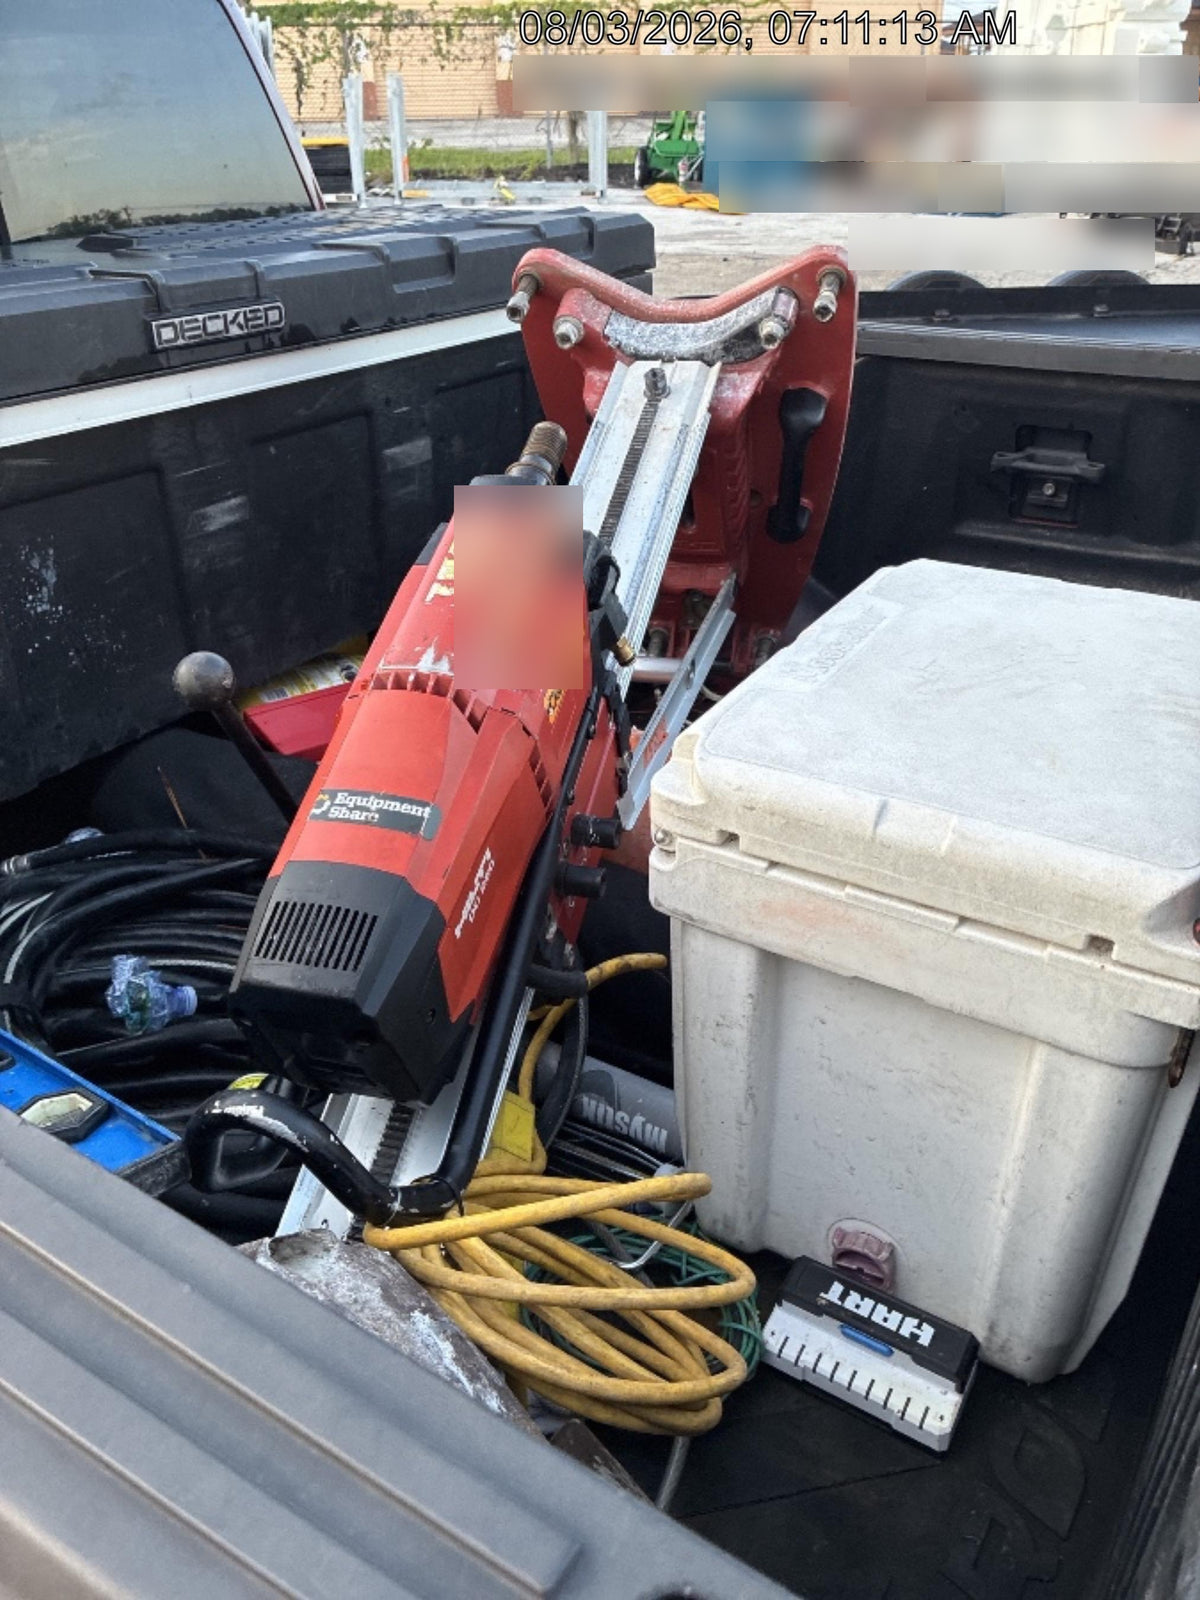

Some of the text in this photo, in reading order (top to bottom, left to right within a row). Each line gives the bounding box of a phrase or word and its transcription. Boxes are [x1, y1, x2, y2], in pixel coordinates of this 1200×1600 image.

[153, 304, 284, 346] DECKED
[333, 791, 432, 818] Equipment
[819, 1280, 935, 1347] HART
